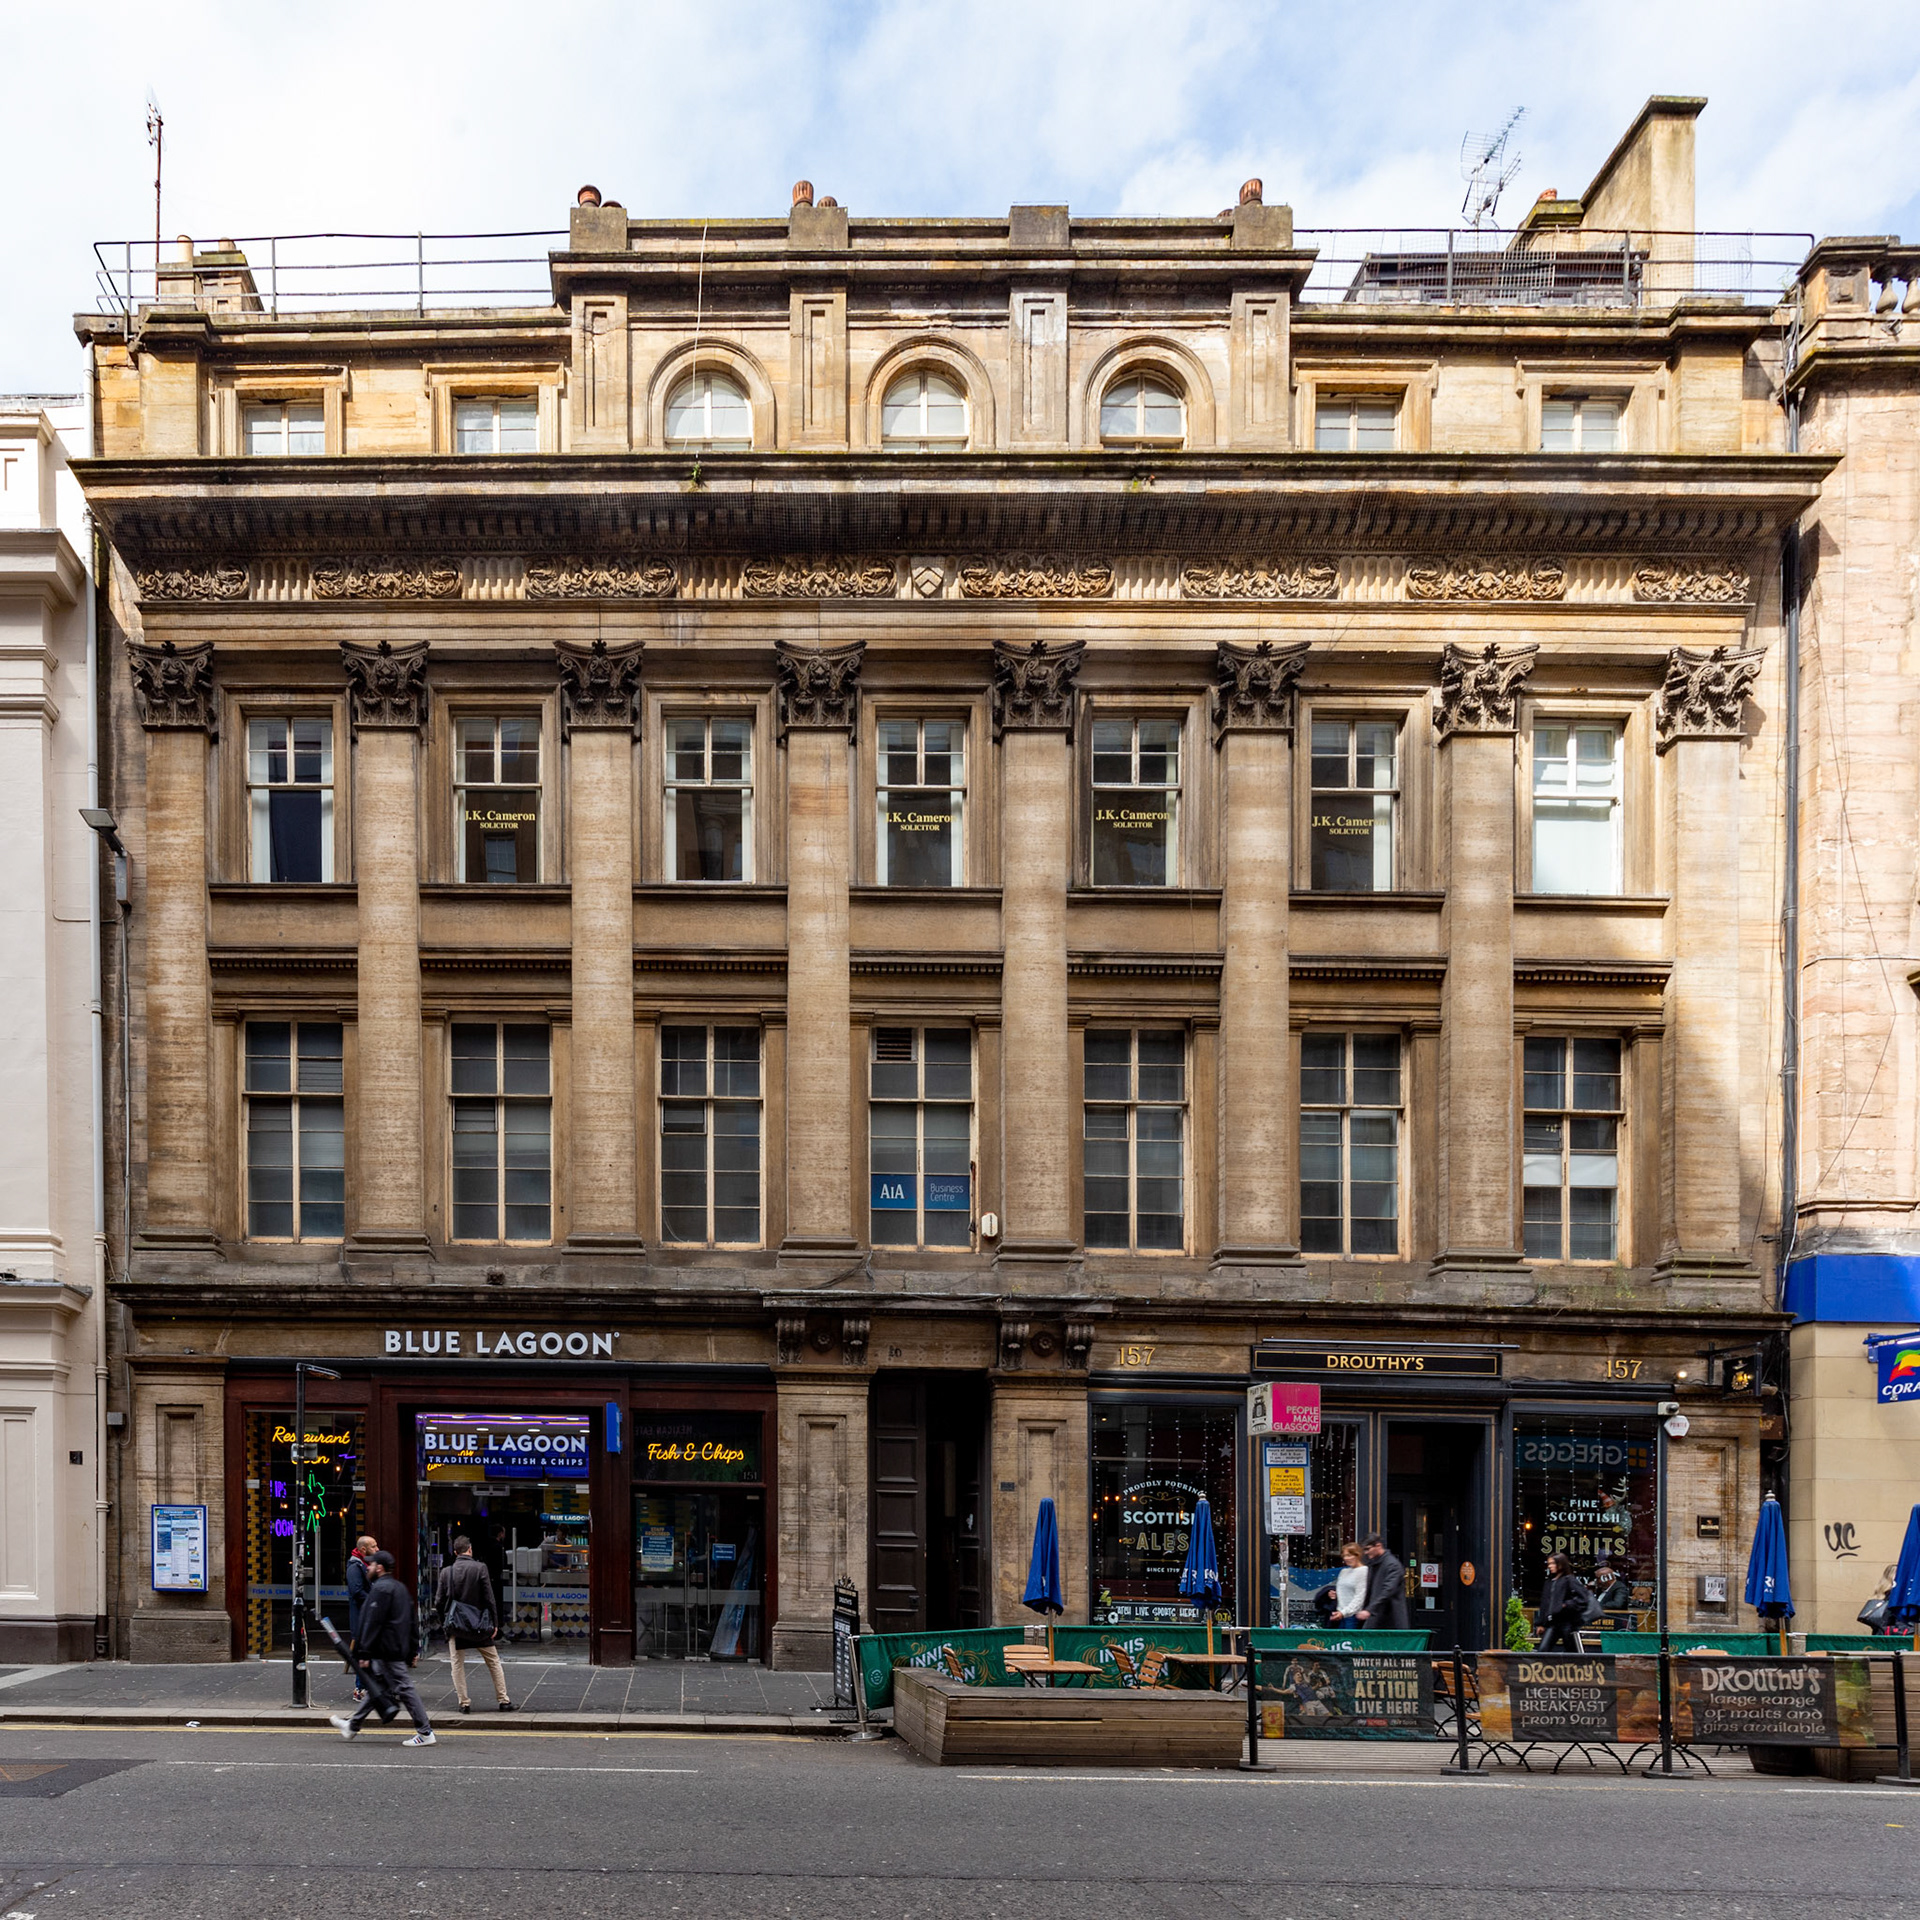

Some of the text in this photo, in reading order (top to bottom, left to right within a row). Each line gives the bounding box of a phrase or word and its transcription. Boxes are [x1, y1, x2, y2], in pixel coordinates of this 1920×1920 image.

[487, 810, 535, 820] Cameron
[907, 812, 956, 822] Cameron
[1120, 810, 1170, 820] Cameron
[930, 1183, 964, 1193] Business
[930, 1193, 955, 1202] Centre
[385, 1330, 612, 1355] BLUE LAGOON
[1119, 1346, 1156, 1366] 157
[1327, 1355, 1424, 1370] DROUTHY'S
[1606, 1359, 1643, 1379] 157
[1286, 1406, 1319, 1415] PEOPLE
[1293, 1415, 1319, 1423] MAKE
[1273, 1422, 1318, 1431] GLASGOW
[272, 1426, 350, 1444] Resaurant
[425, 1434, 586, 1452] BLUE LAGOON
[648, 1442, 744, 1464] Fish & Chips
[429, 1456, 504, 1465] TRADITIONAL
[743, 1472, 757, 1480] 151
[1123, 1480, 1162, 1495] PROUDLY
[1570, 1500, 1598, 1508] FINE
[1550, 1512, 1620, 1523] SCOTTISH
[1136, 1532, 1189, 1551] ALES
[1541, 1535, 1626, 1555] SPIRITS
[1135, 1607, 1149, 1616] LIVE
[1152, 1608, 1176, 1616] SPORTS
[1180, 1608, 1199, 1618] HERE!
[1353, 1658, 1416, 1667] WATCH ALL THE
[1353, 1670, 1418, 1679] BEST SPORTING
[1355, 1680, 1418, 1699] ACTION
[1526, 1687, 1600, 1700] LICENSED
[1710, 1694, 1756, 1706] large
[1355, 1701, 1418, 1714] LIVE HERE
[1520, 1701, 1607, 1712] BREAKFAST
[1570, 1714, 1607, 1727] 9am
[1704, 1708, 1822, 1721] of malts and
[1703, 1721, 1826, 1734] gins available
